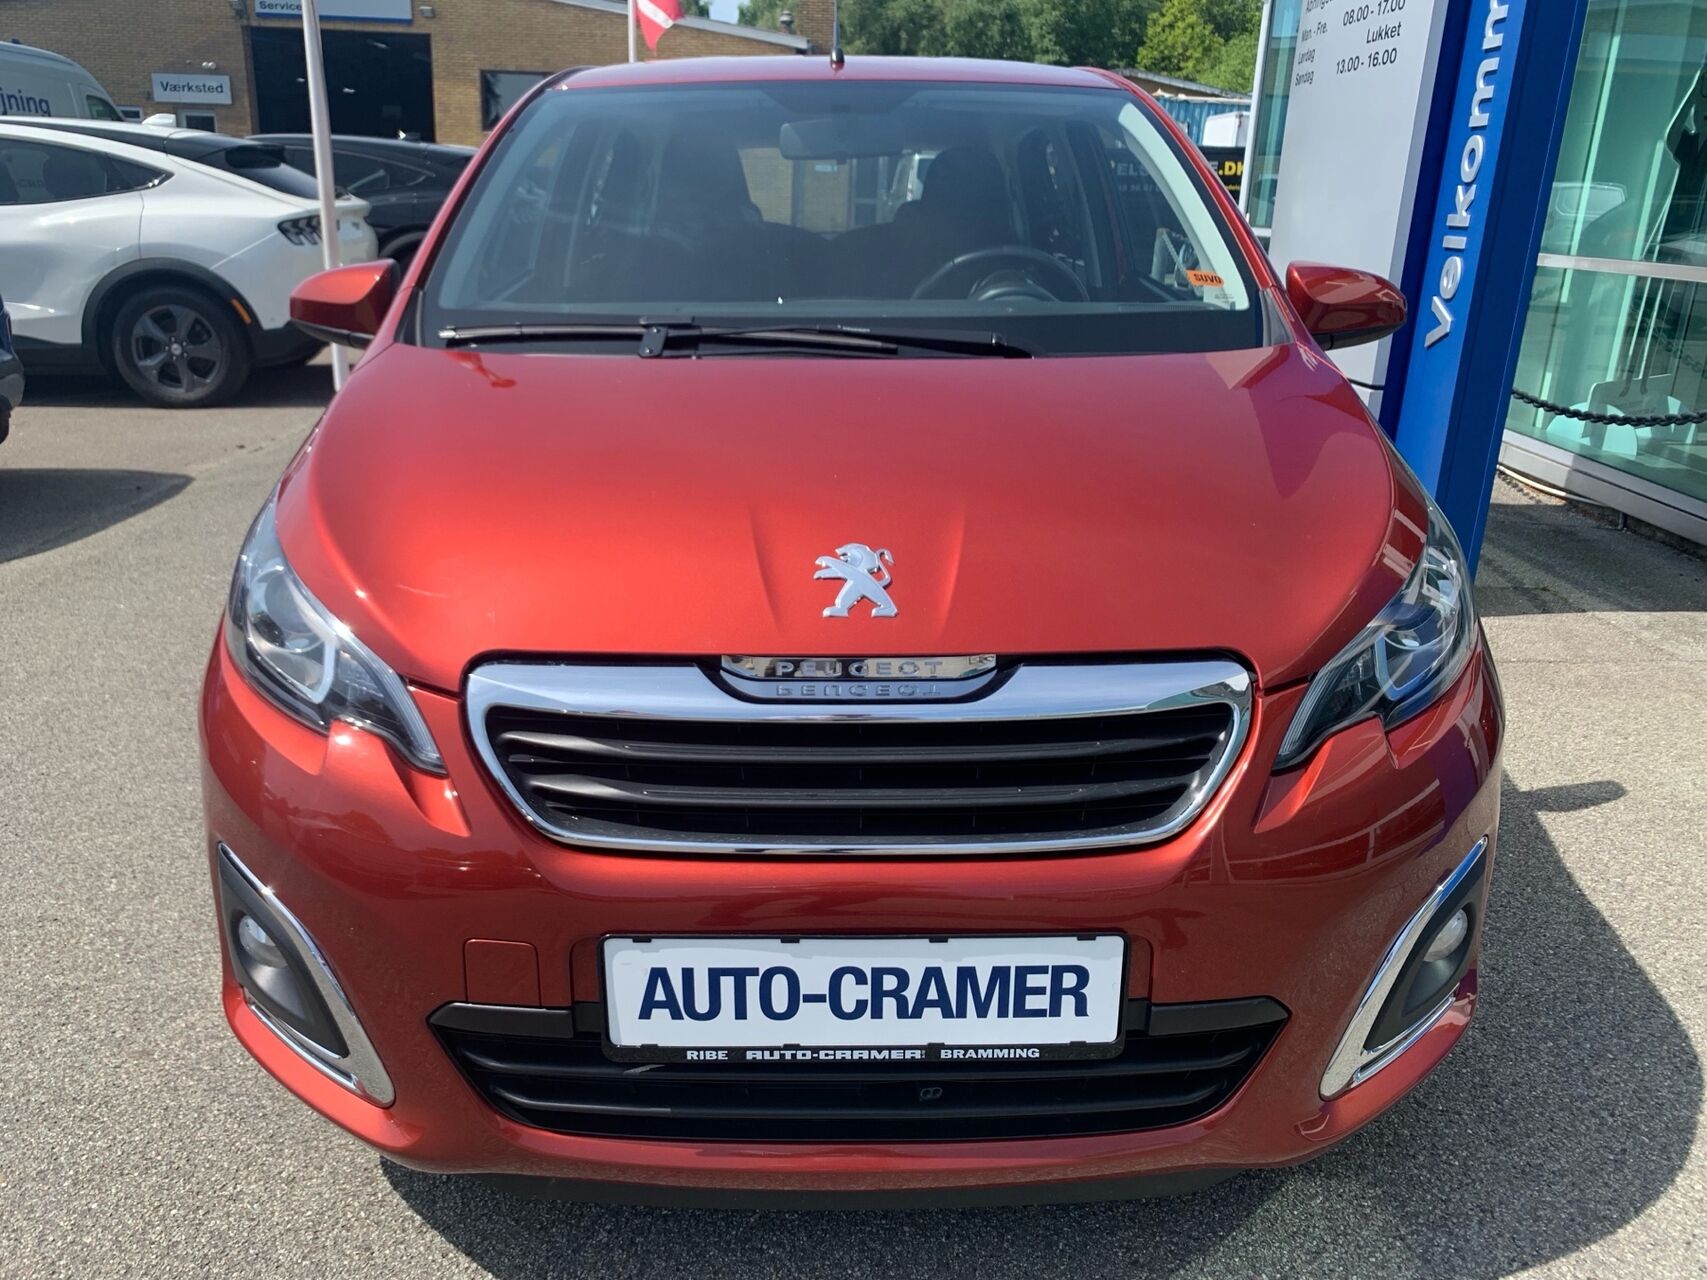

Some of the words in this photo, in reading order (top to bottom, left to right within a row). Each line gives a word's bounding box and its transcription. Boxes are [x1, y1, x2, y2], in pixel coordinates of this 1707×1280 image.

[1343, 5, 1369, 26] 08.00
[1377, 0, 1406, 16] 17.00
[1366, 21, 1402, 43] Lukket
[1336, 55, 1360, 74] 13.00
[1368, 48, 1397, 68] 16.00
[159, 81, 224, 94] Værksted
[775, 661, 943, 677] PEUGEOT
[638, 964, 1090, 1021] AUTO-CRAMER
[686, 1050, 729, 1061] RIBE
[746, 1050, 922, 1060] AUTO-CRAMER
[940, 1048, 1040, 1060] BRAMMING
